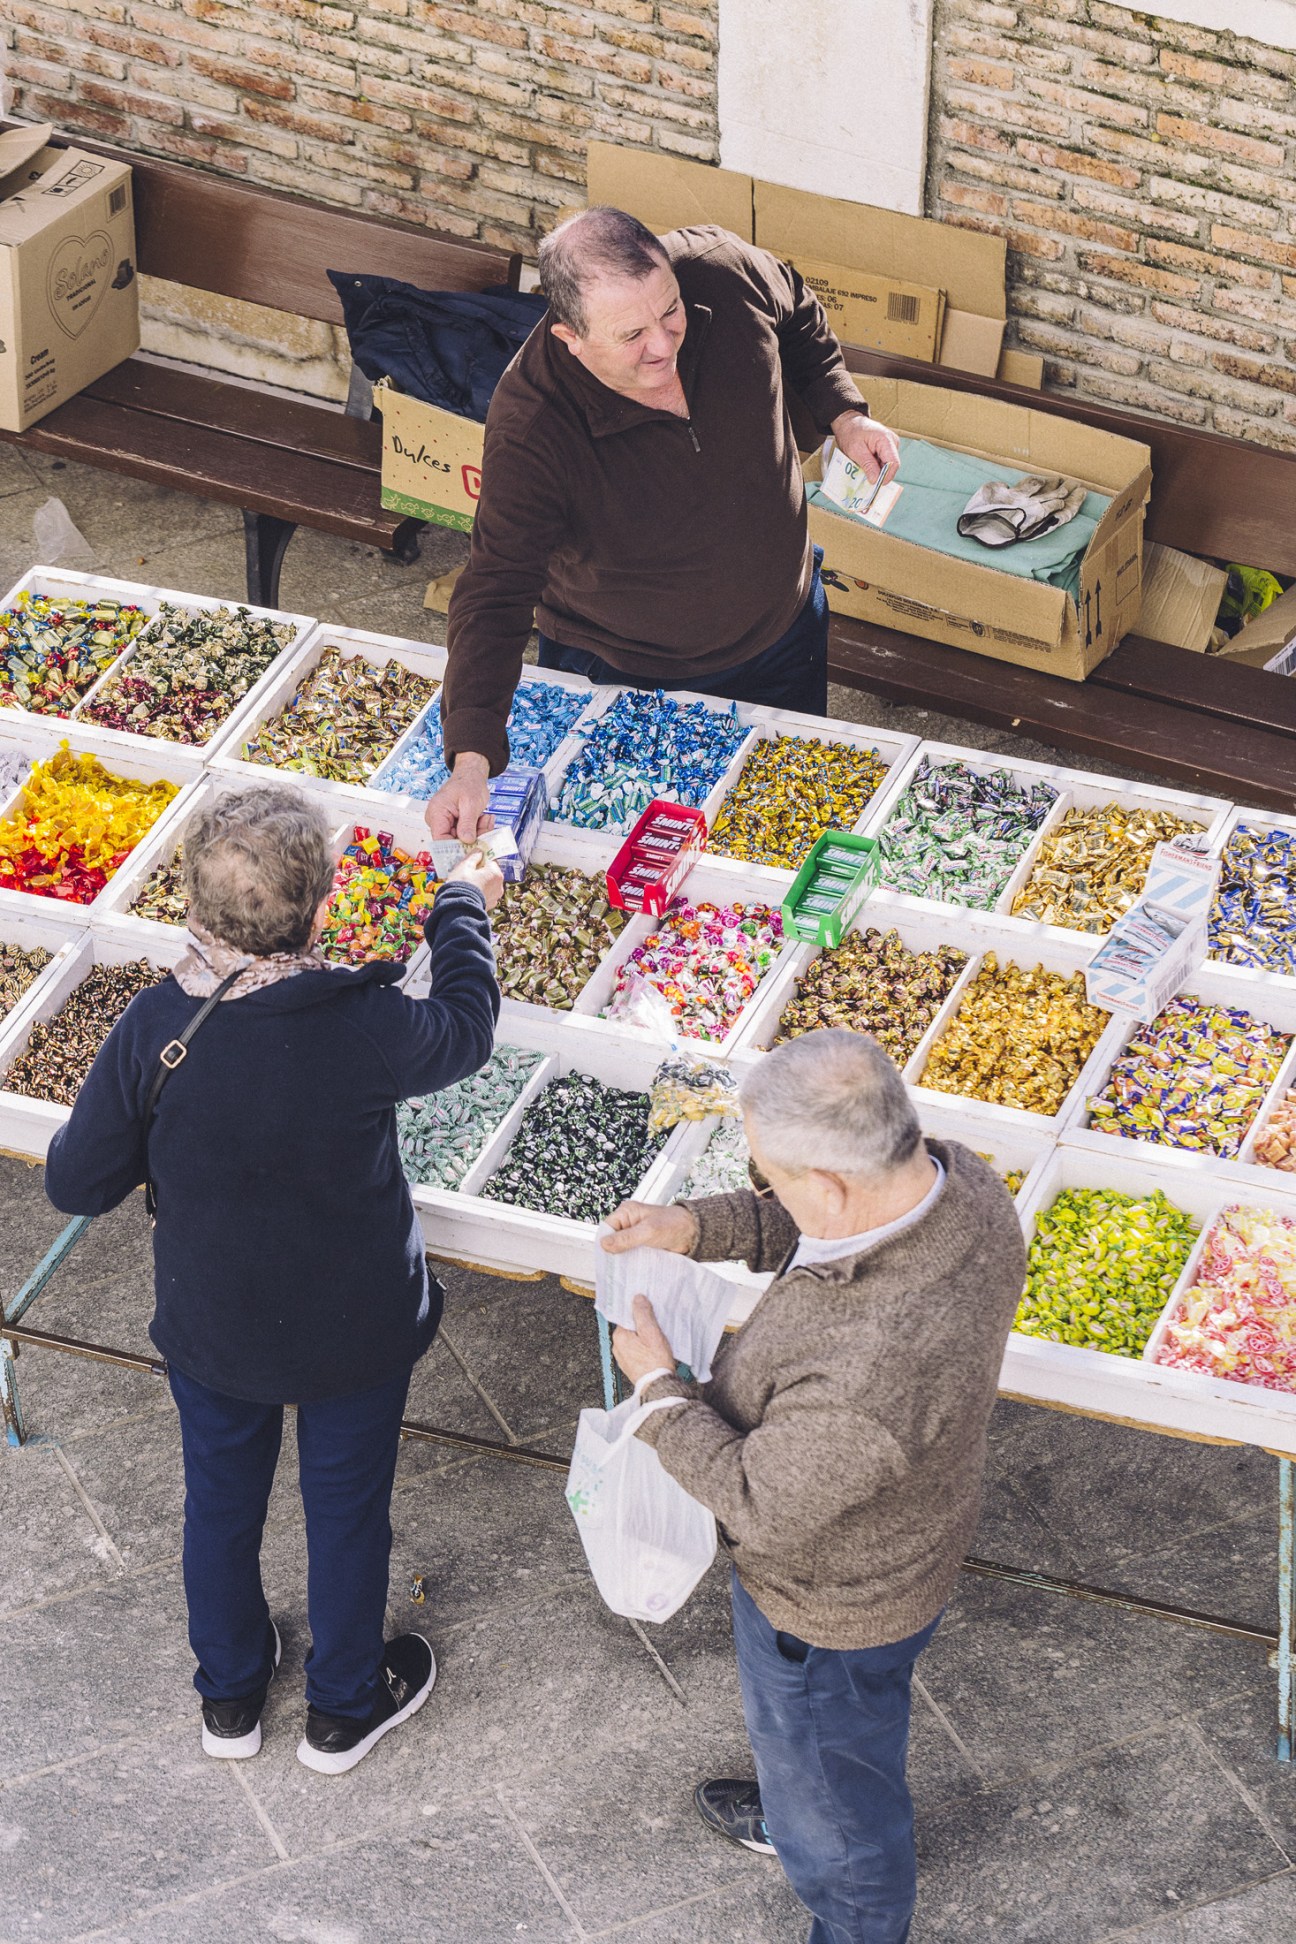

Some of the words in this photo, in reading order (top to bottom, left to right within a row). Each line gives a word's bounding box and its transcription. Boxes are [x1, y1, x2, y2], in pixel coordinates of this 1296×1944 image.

[55, 249, 108, 300] Solano
[805, 276, 829, 287] 02109
[391, 435, 451, 473] Dulces
[845, 461, 859, 480] 20
[628, 866, 663, 879] SMIN
